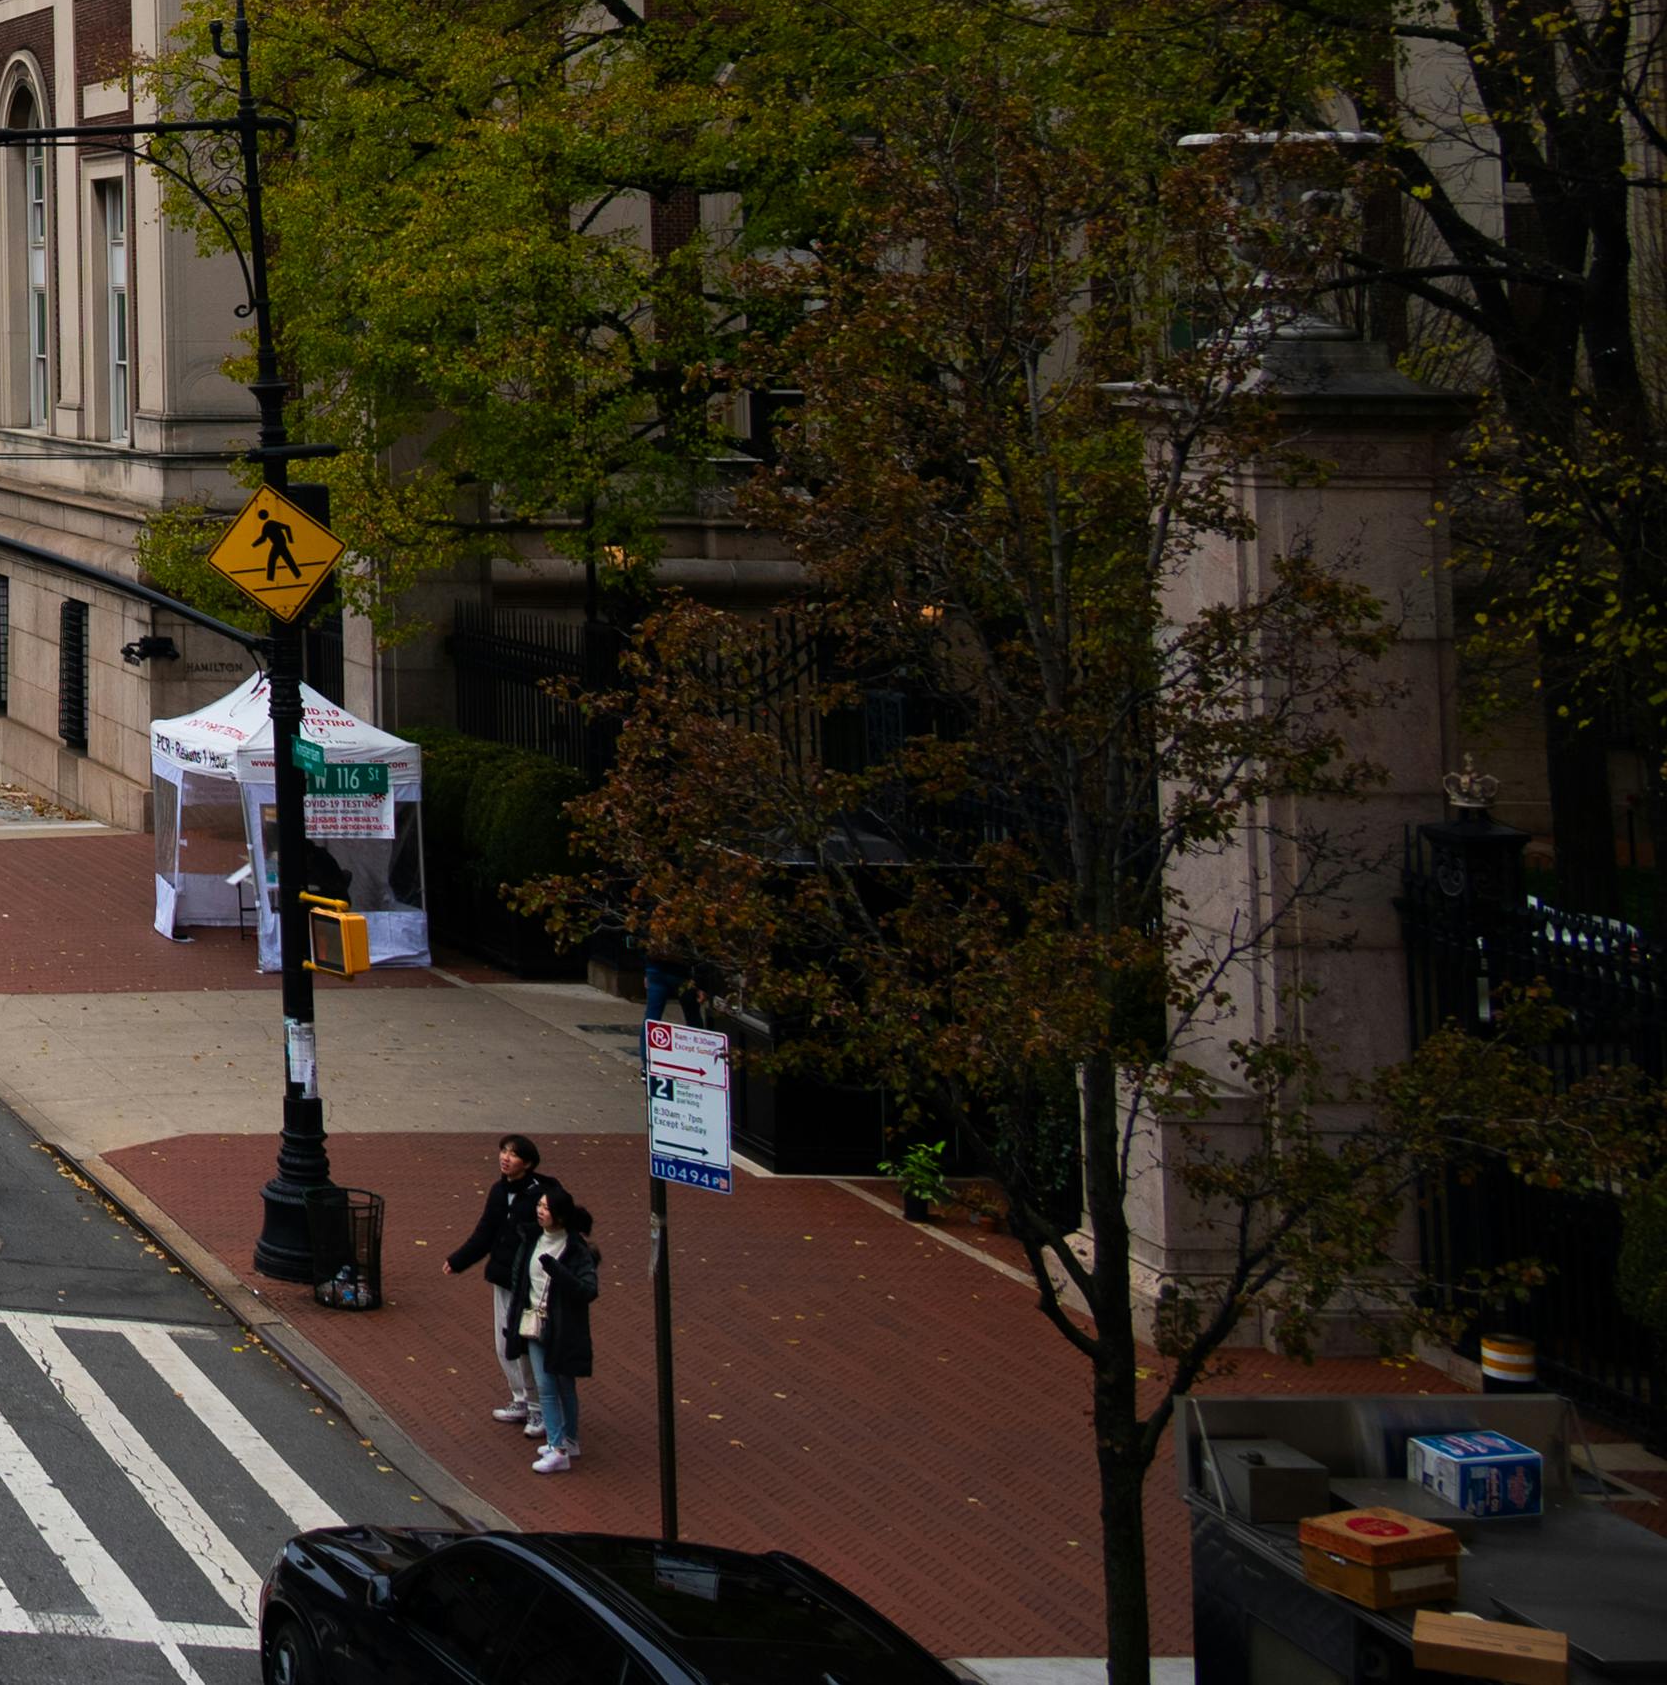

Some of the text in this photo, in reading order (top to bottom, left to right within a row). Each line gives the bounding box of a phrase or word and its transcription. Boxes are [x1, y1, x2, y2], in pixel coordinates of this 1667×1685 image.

[186, 662, 243, 673] HAMILTON
[304, 718, 355, 727] TESTING
[156, 734, 170, 754] PCR
[208, 749, 228, 769] Hour
[315, 767, 379, 789] W 116 St
[304, 800, 378, 808] OVID-19 TESTING
[675, 1042, 718, 1057] Except Sunda
[655, 1076, 668, 1098] 2
[676, 1089, 703, 1100] metered
[676, 1097, 700, 1108] parking
[654, 1106, 681, 1120] 8:30am
[688, 1114, 703, 1125] 7pm
[654, 1116, 707, 1136] Except Sunday
[654, 1161, 709, 1186] 110494
